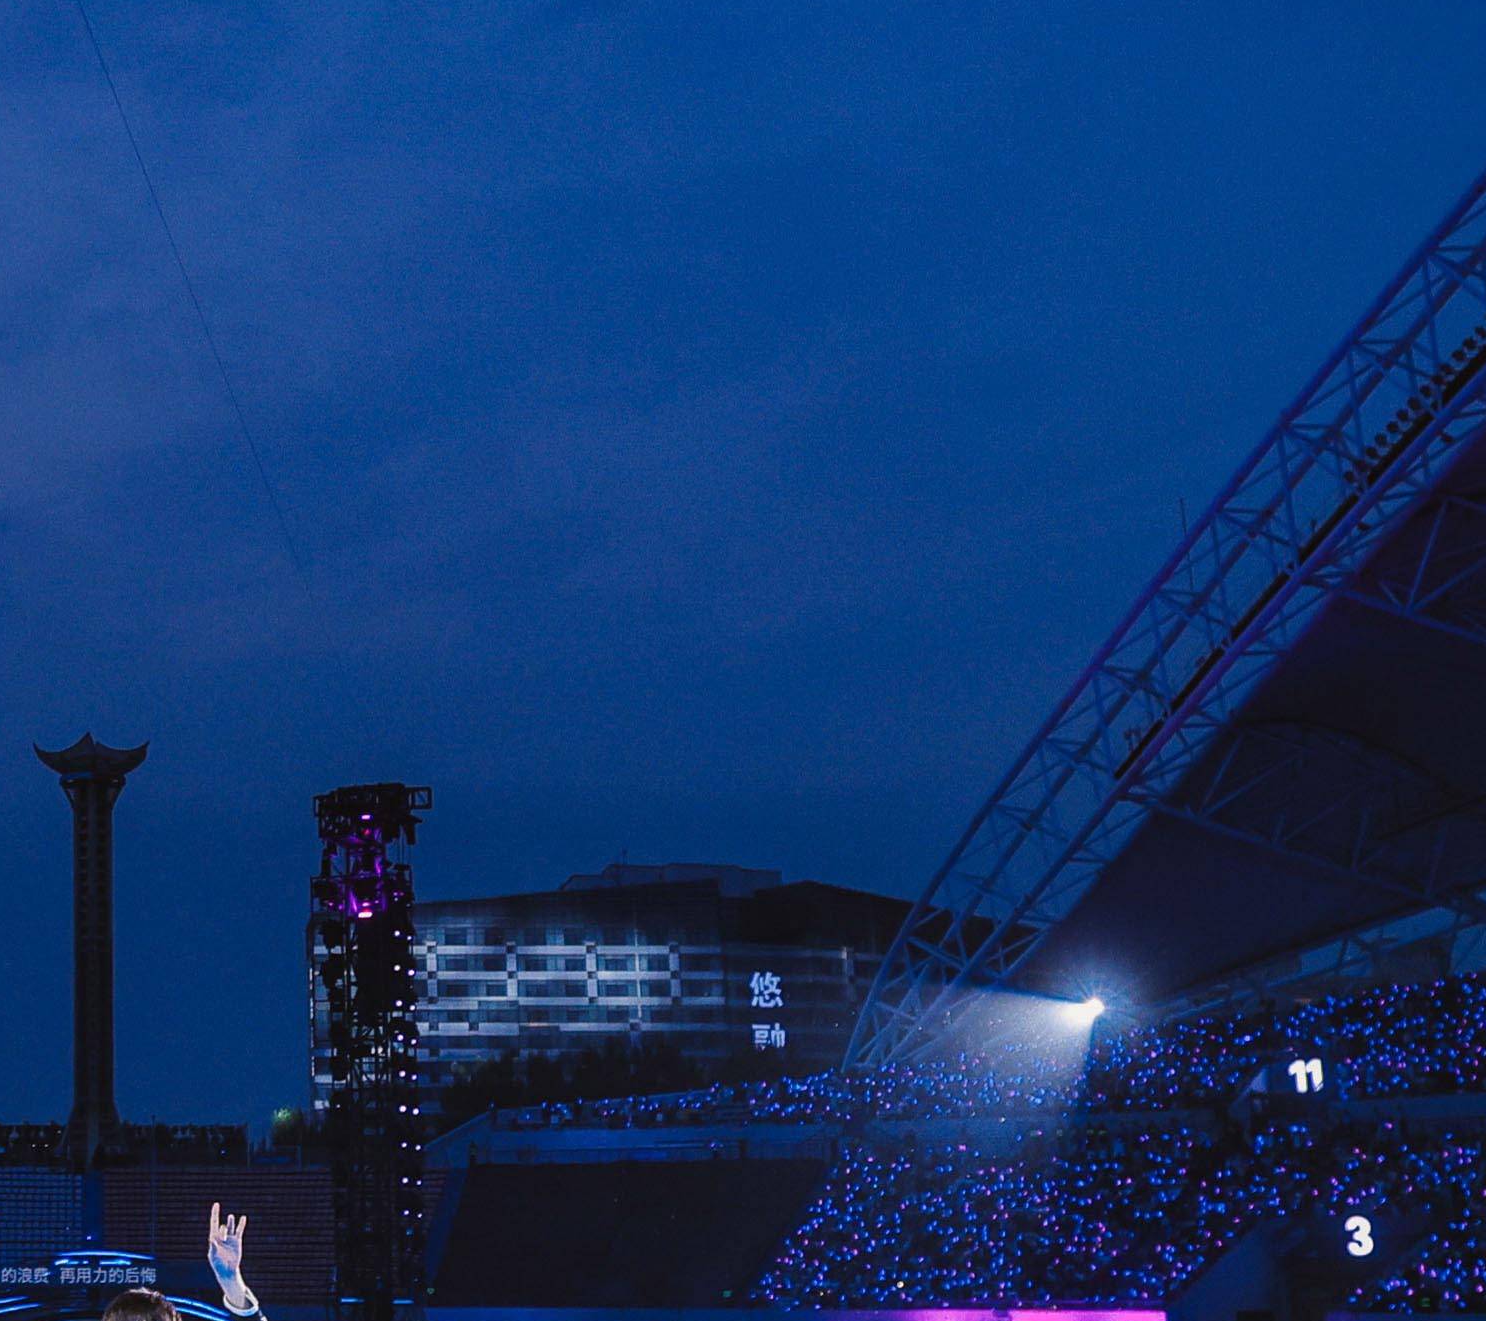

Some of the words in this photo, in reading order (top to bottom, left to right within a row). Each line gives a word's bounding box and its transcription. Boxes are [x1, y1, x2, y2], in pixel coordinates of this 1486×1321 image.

[1288, 1058, 1324, 1094] 11
[1344, 1215, 1374, 1257] 3
[60, 1267, 157, 1284] 再用力的后悔
